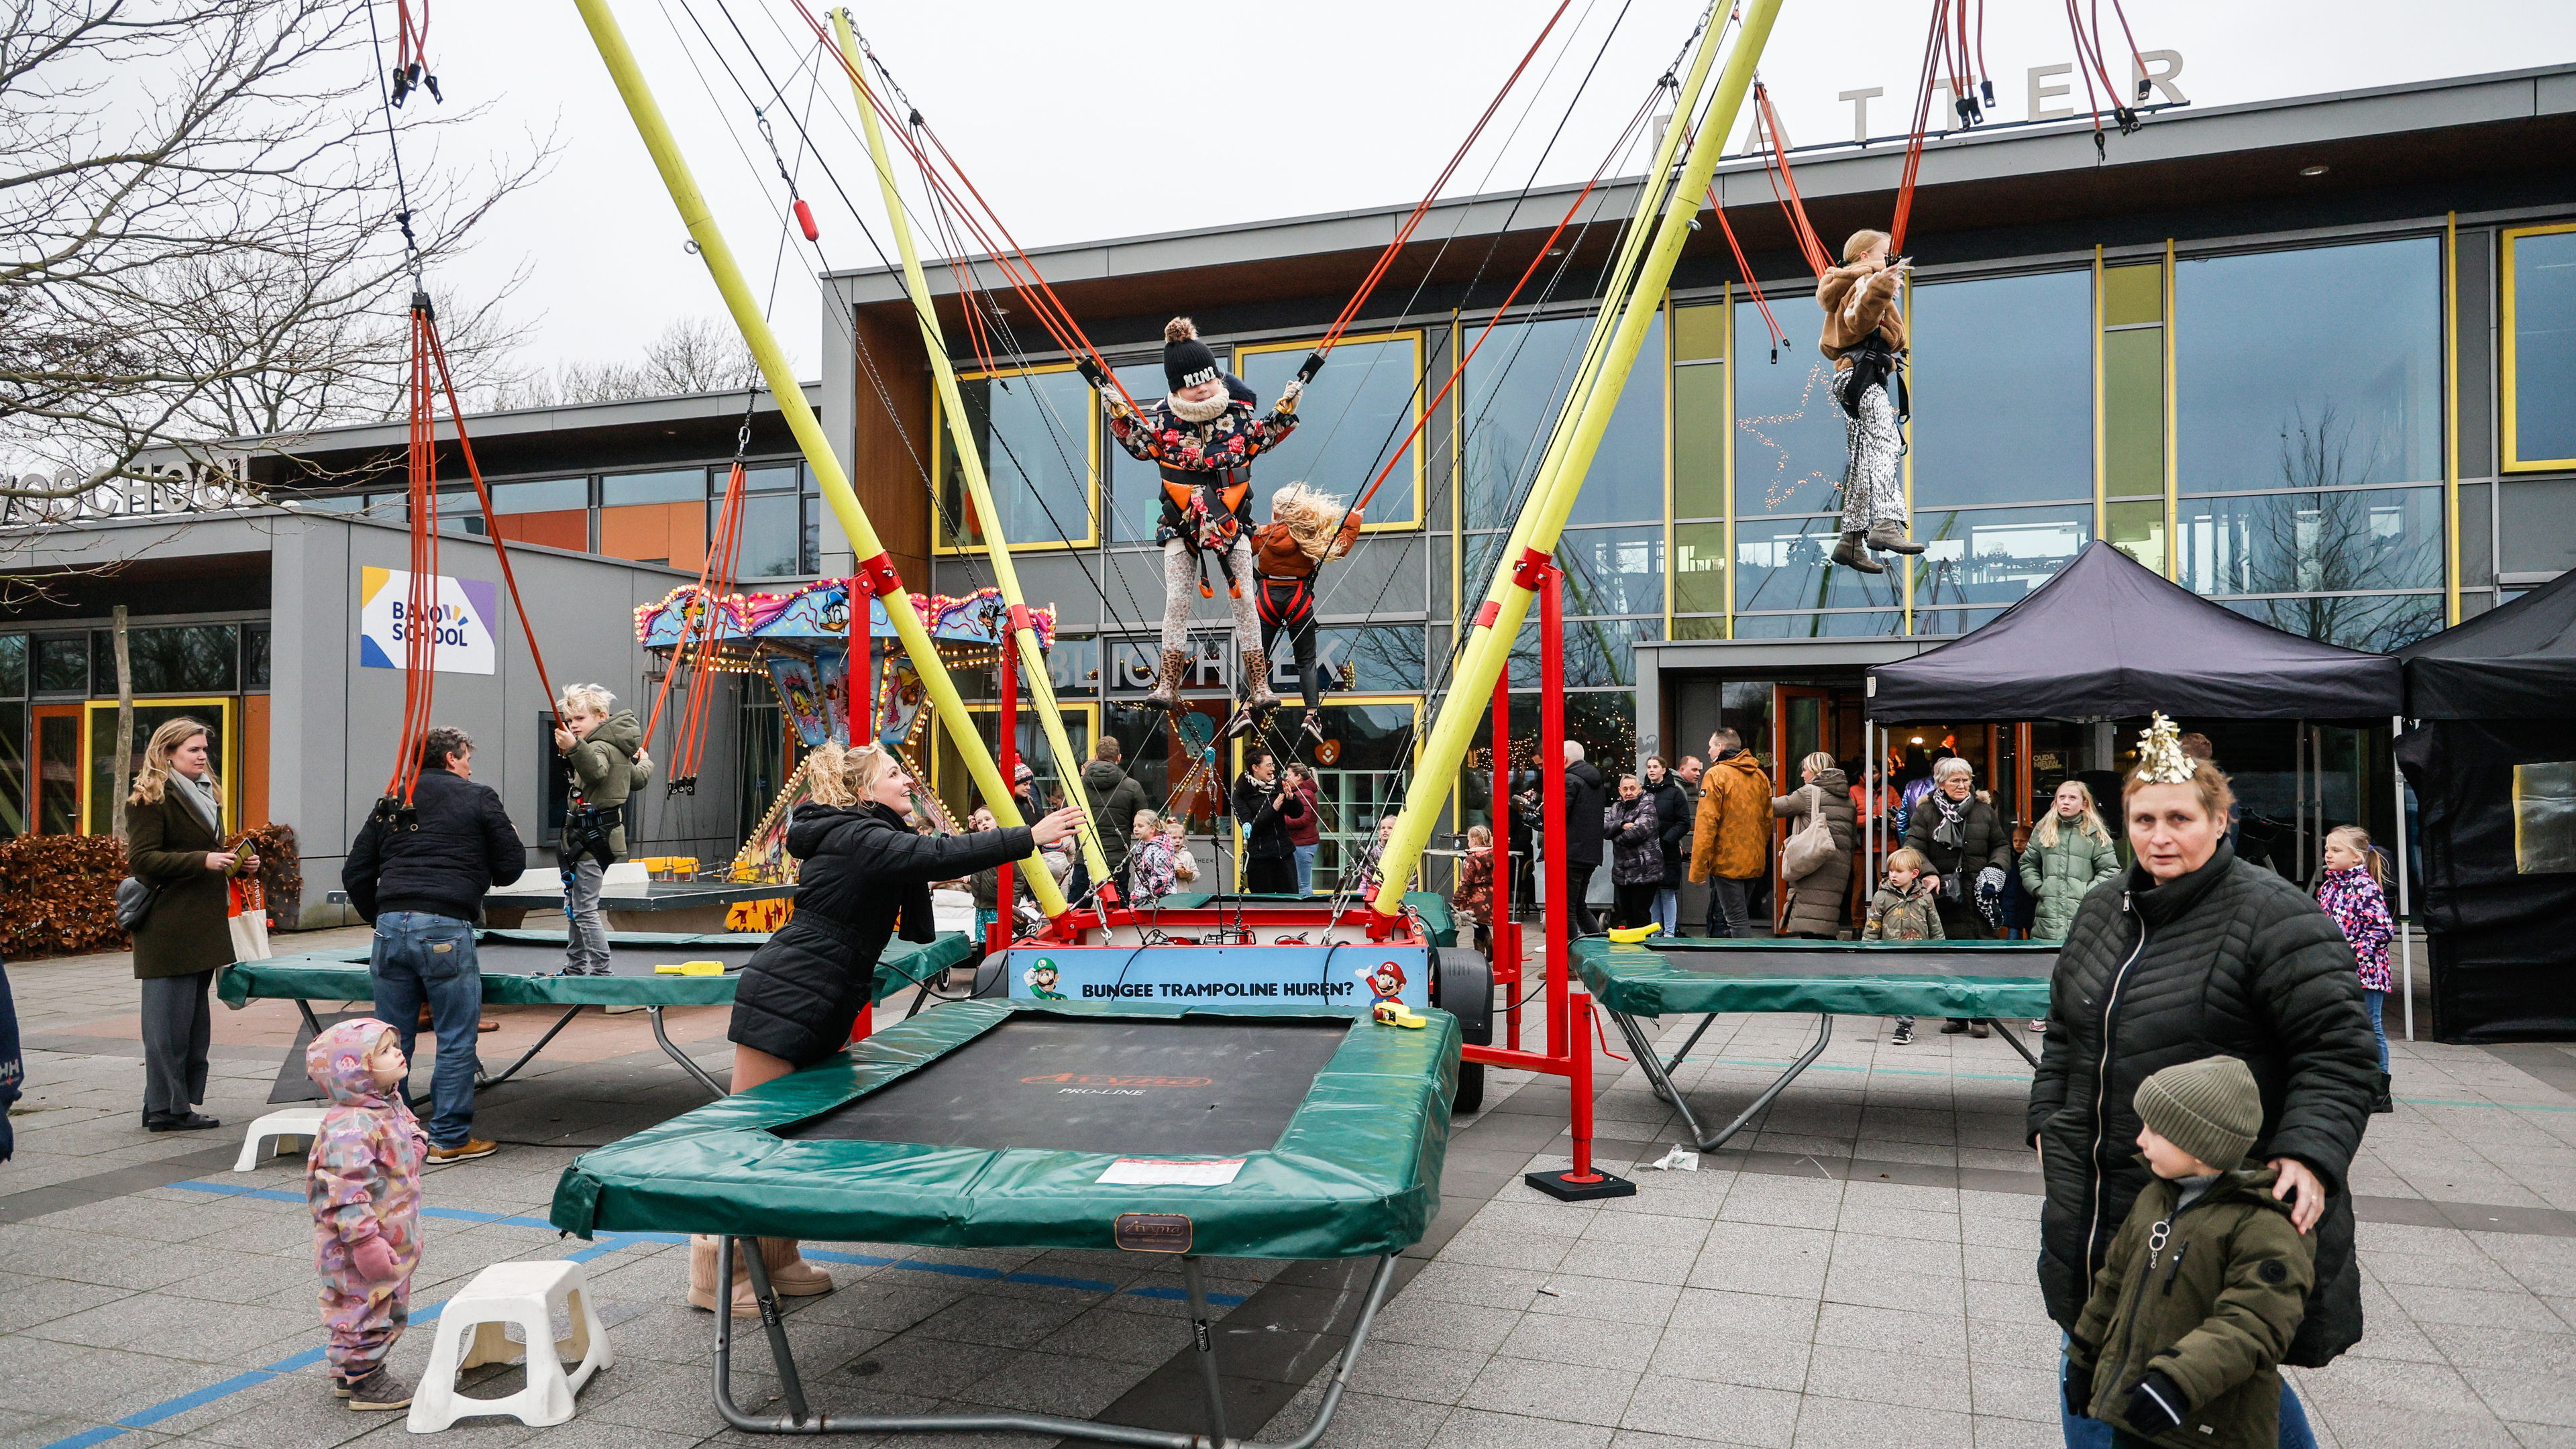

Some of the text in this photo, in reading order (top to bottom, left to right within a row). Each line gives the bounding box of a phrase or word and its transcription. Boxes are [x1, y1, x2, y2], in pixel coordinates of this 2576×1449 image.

[1183, 366, 1216, 388] MINI
[1082, 981, 1354, 997] BUNGEE TRAMPOLINE HUREN?
[1057, 1087, 1146, 1095] PRO-LINE
